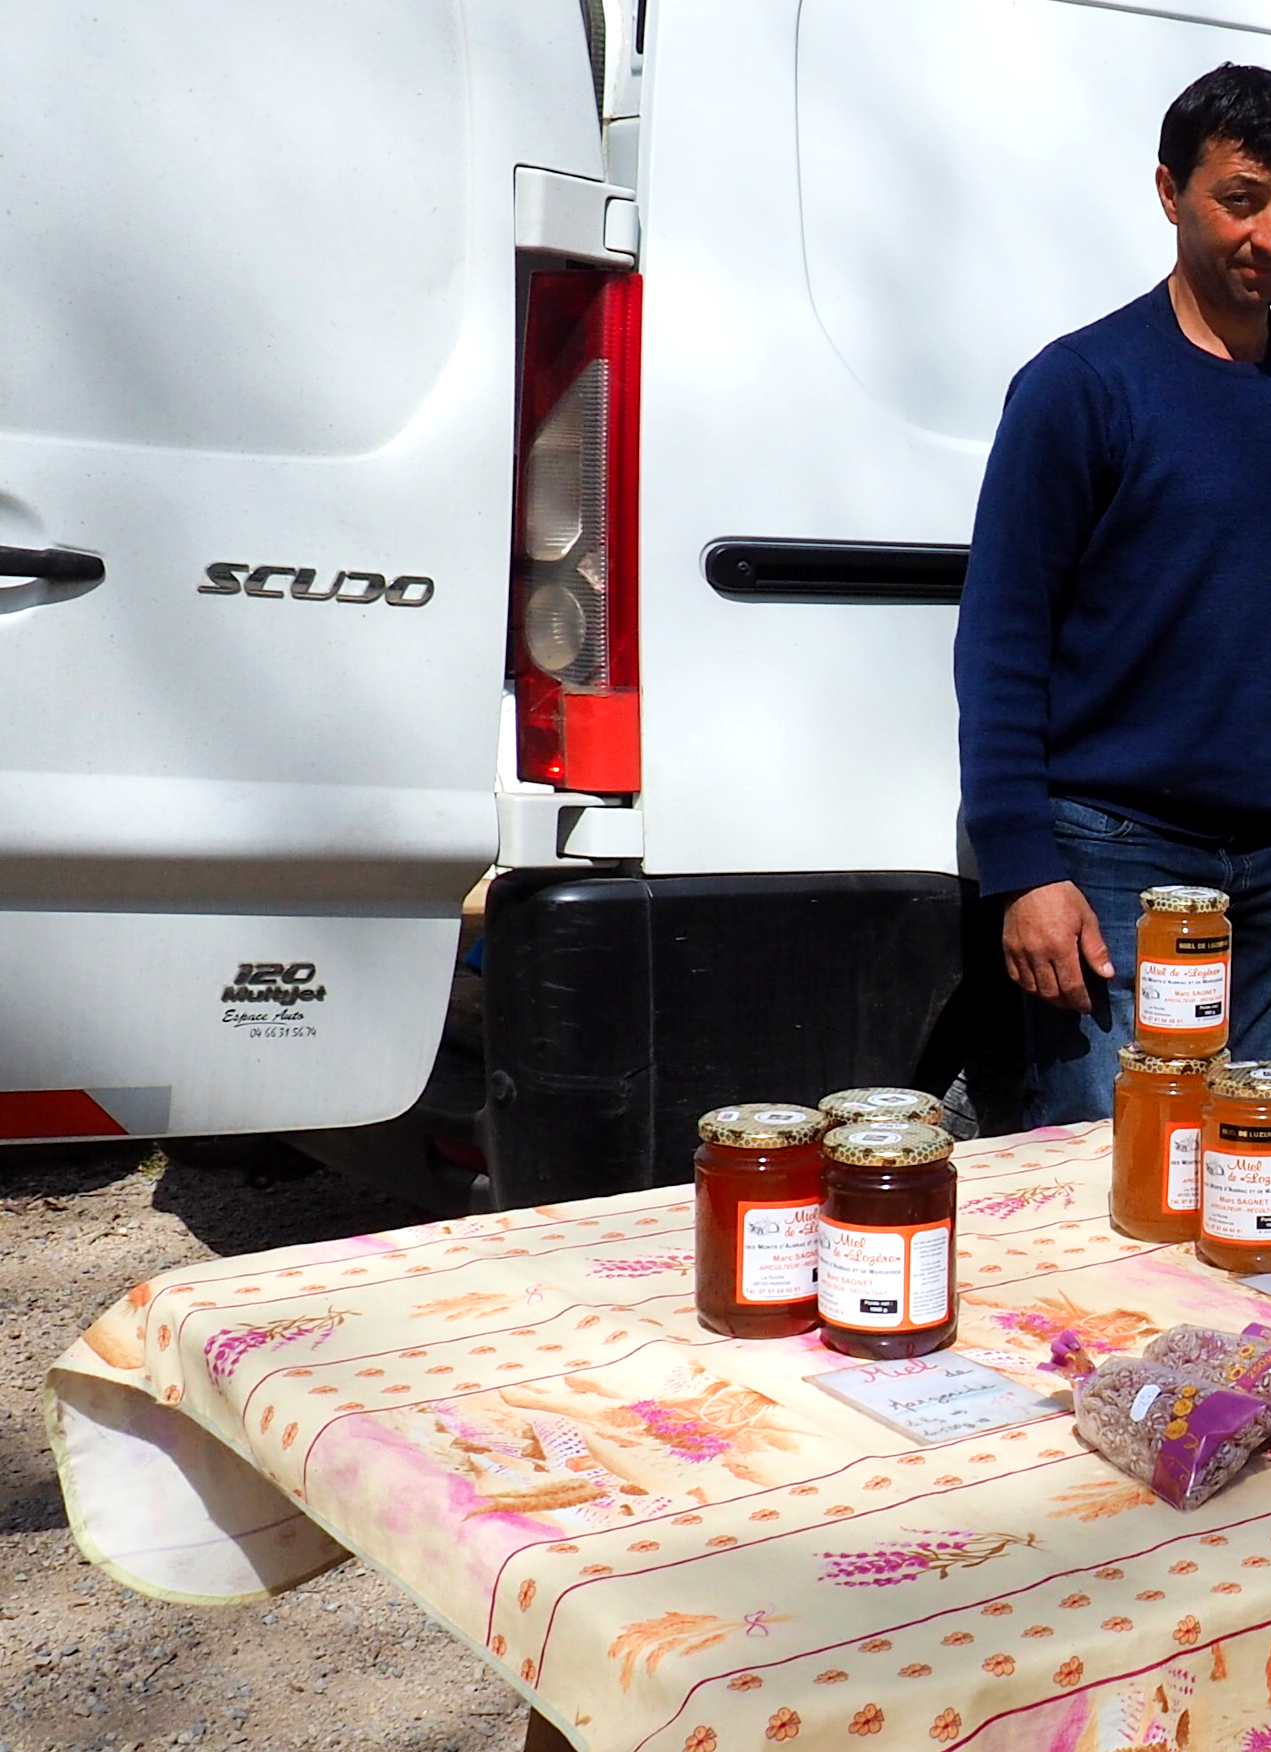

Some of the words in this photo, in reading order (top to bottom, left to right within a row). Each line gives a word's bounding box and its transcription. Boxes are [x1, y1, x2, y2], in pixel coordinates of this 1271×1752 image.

[197, 562, 435, 607] SCUDO
[234, 963, 316, 985] 120
[1170, 968, 1180, 977] de
[222, 1008, 269, 1023] Espace
[272, 1008, 305, 1022] Auto
[249, 1028, 262, 1038] 04
[264, 1027, 276, 1038] 66
[1227, 1159, 1262, 1172] Miel
[1227, 1172, 1237, 1183] de
[785, 1208, 818, 1225] Miel
[785, 1226, 795, 1237] de
[833, 1233, 866, 1248] Miel
[773, 1254, 793, 1262] Marc
[841, 1276, 873, 1287] SAGNET
[863, 1357, 938, 1383] Miel
